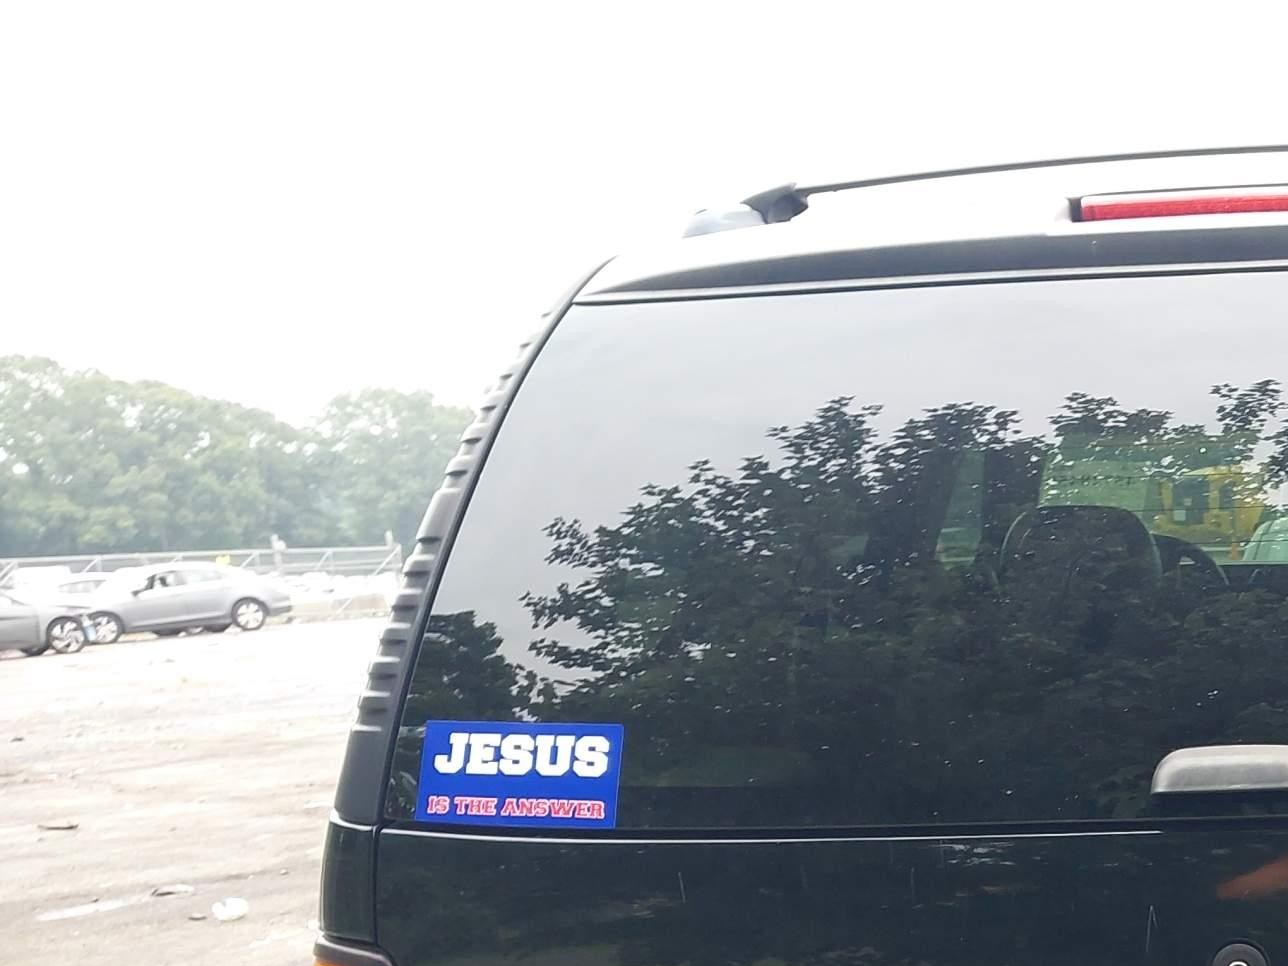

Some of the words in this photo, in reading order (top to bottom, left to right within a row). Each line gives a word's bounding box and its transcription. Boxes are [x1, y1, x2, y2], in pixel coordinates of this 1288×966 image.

[434, 732, 610, 778] JESUS
[426, 795, 449, 815] IS
[454, 796, 498, 815] THE
[500, 798, 605, 819] ANSWER
